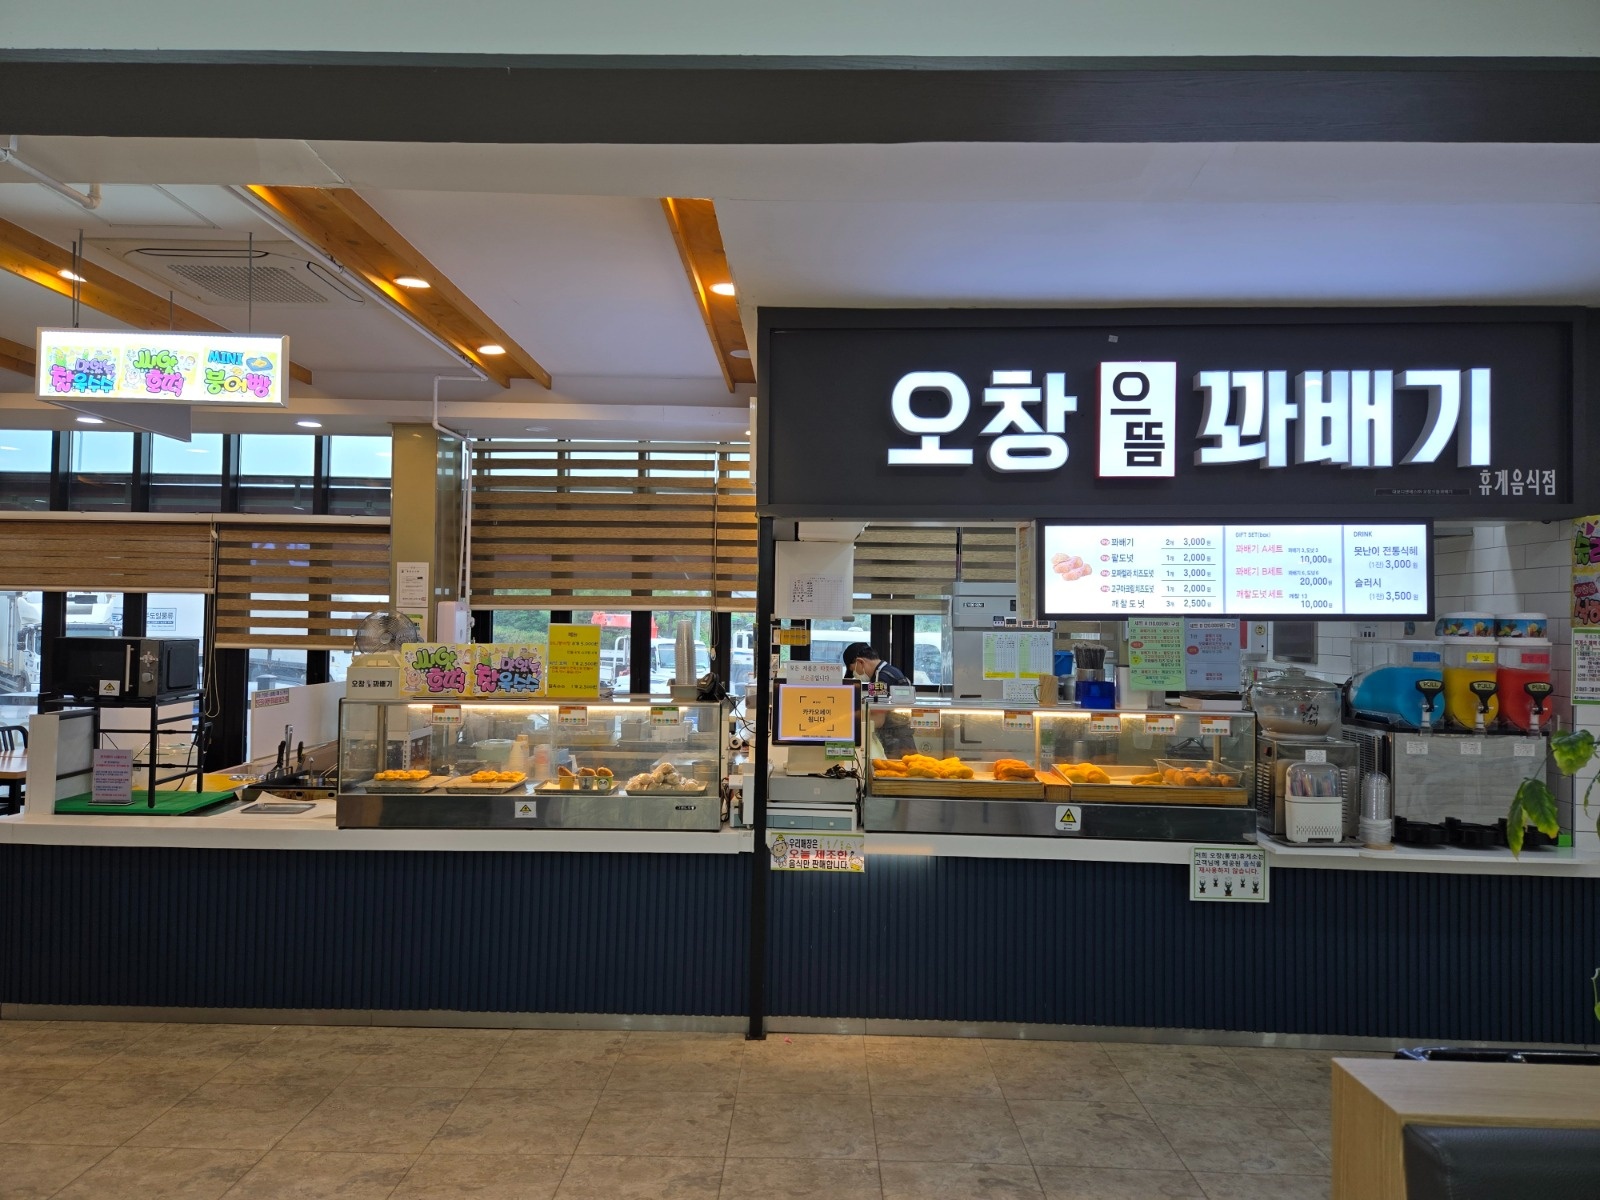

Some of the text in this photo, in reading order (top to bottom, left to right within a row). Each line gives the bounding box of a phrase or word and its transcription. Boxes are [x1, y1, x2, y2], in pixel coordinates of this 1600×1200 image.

[134, 349, 178, 374] 씨앗
[208, 350, 245, 367] MINI
[75, 357, 116, 376] 맛있는
[145, 369, 184, 398] 호떡
[204, 367, 271, 398] 붕어빵
[887, 367, 1491, 472] 오창 으뜸 꽈배기
[1479, 469, 1556, 496] 휴게음식점
[1235, 531, 1248, 539] GIFT
[1111, 538, 1134, 547] 꽈배기
[1236, 544, 1259, 554] 꽈배기
[1261, 544, 1283, 554] A세트
[1354, 546, 1419, 556] 못난이 전통식혜
[1368, 561, 1384, 570] (1잔)
[1236, 567, 1259, 577] 꽈배기
[1261, 567, 1283, 577] B세트
[1354, 578, 1382, 588] 슬러시
[1369, 592, 1385, 601] (1잔)
[412, 647, 457, 671] 씨앗
[500, 656, 543, 675] 맛있는
[803, 665, 817, 673] 제품은
[819, 665, 841, 673] 따뜻하게
[425, 667, 466, 694] 호떡
[475, 663, 540, 693] 찰옥수수
[352, 680, 365, 688] 오창
[802, 708, 831, 716] 카카오페이
[789, 838, 818, 849] 우리매장은
[789, 849, 848, 860] 오늘 제조한
[789, 859, 849, 870] 음식만 판매합니다.
[1222, 860, 1241, 868] 제공된
